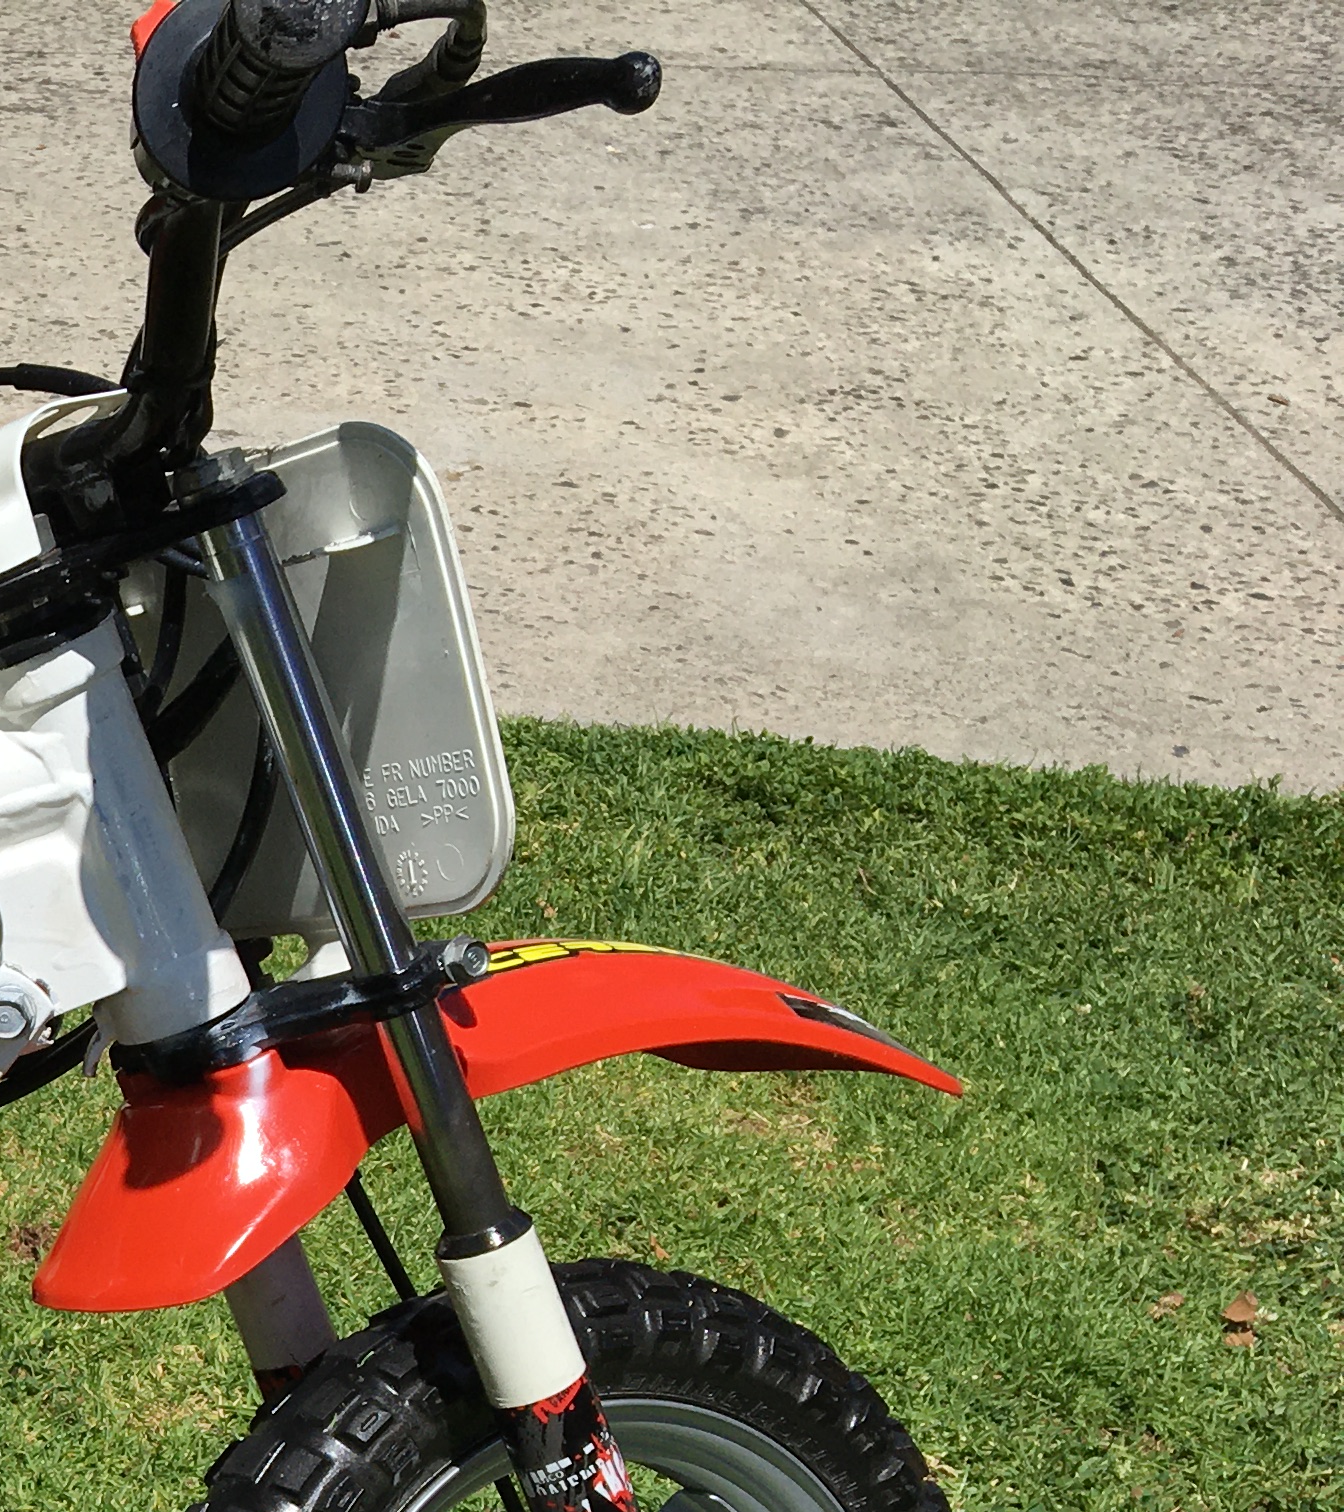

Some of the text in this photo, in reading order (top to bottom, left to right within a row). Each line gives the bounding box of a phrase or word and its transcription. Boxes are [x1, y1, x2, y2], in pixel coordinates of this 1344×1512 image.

[381, 762, 404, 783] FR
[408, 749, 476, 780] NUMBER
[386, 785, 428, 808] GELA
[435, 775, 481, 799] 7000
